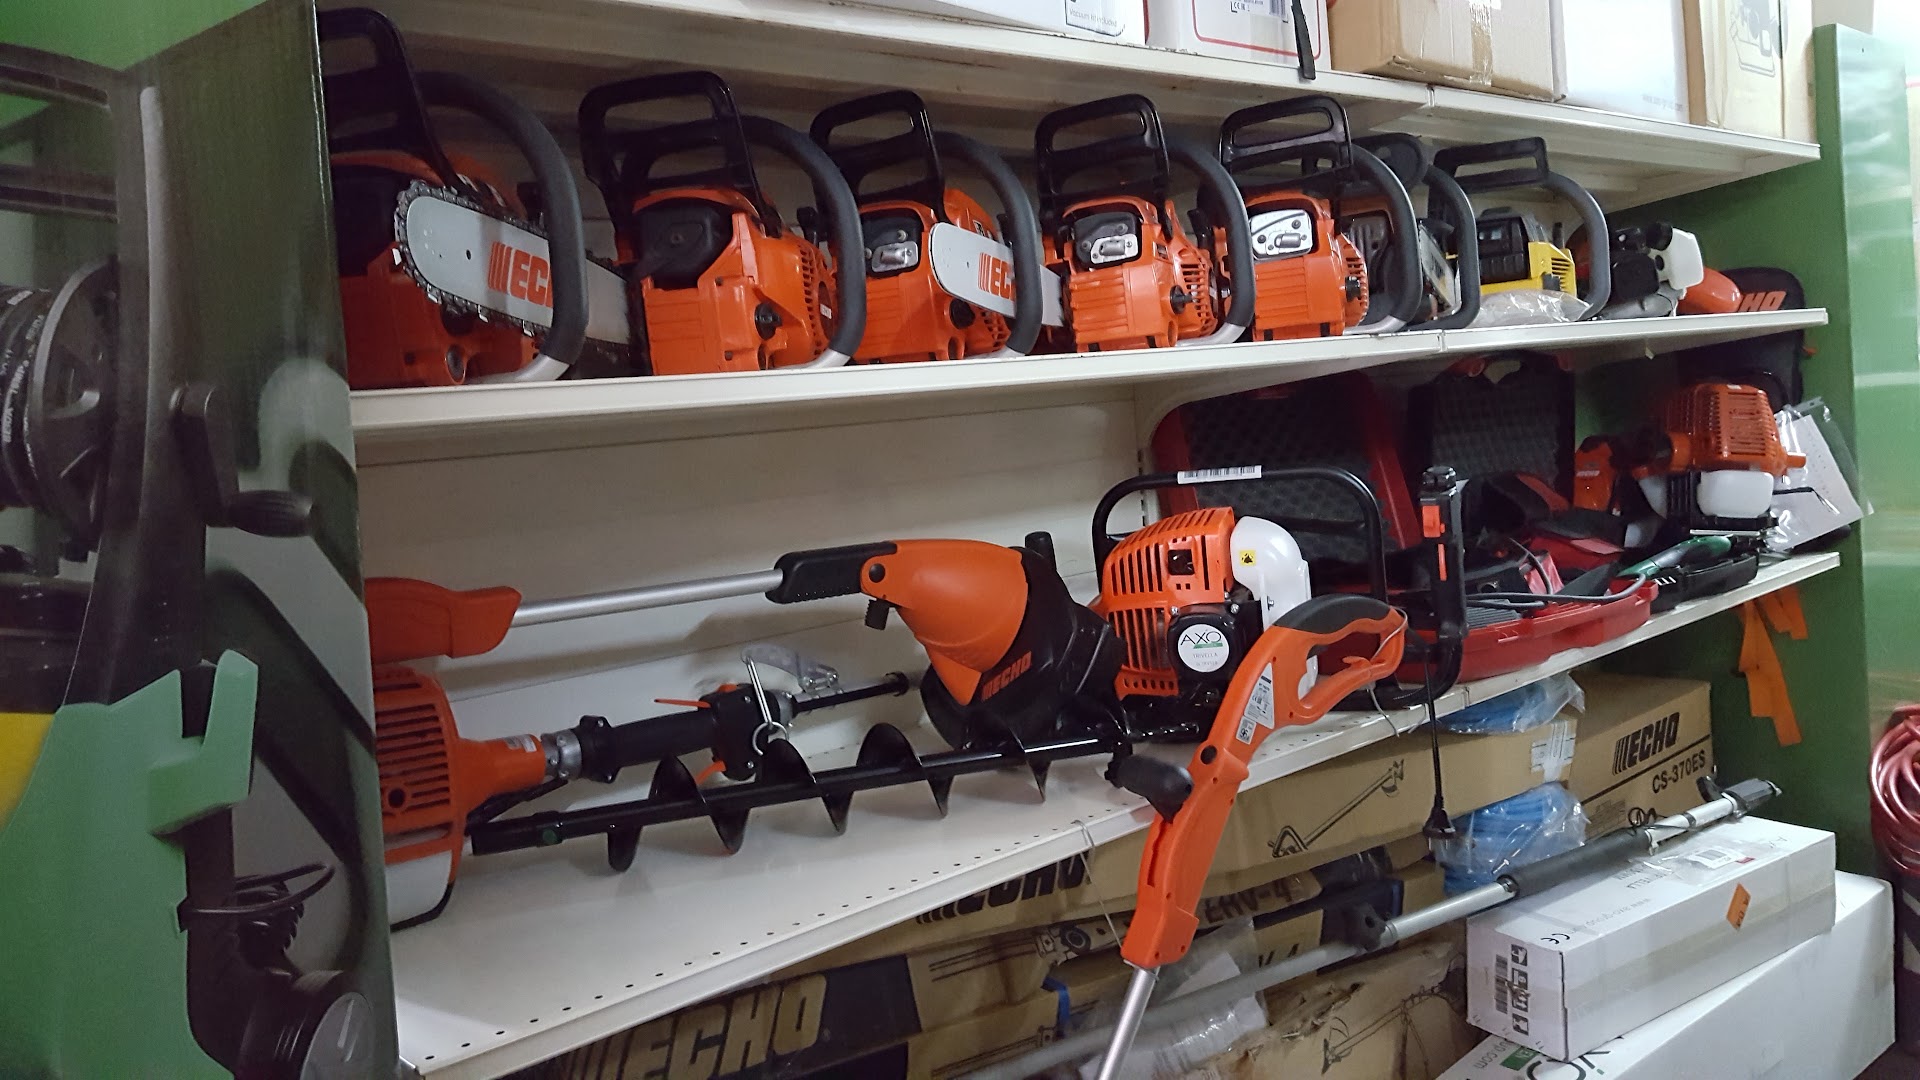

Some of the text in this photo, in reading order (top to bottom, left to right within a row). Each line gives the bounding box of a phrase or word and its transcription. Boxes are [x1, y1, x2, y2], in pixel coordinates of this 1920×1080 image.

[510, 248, 553, 309] EC
[990, 255, 1017, 303] EC
[1738, 290, 1787, 312] HO
[1626, 711, 1680, 769] ECHO
[1652, 749, 1706, 794] CS-370ES
[622, 972, 828, 1080] ECHO
[1473, 1041, 1508, 1070] up.com
